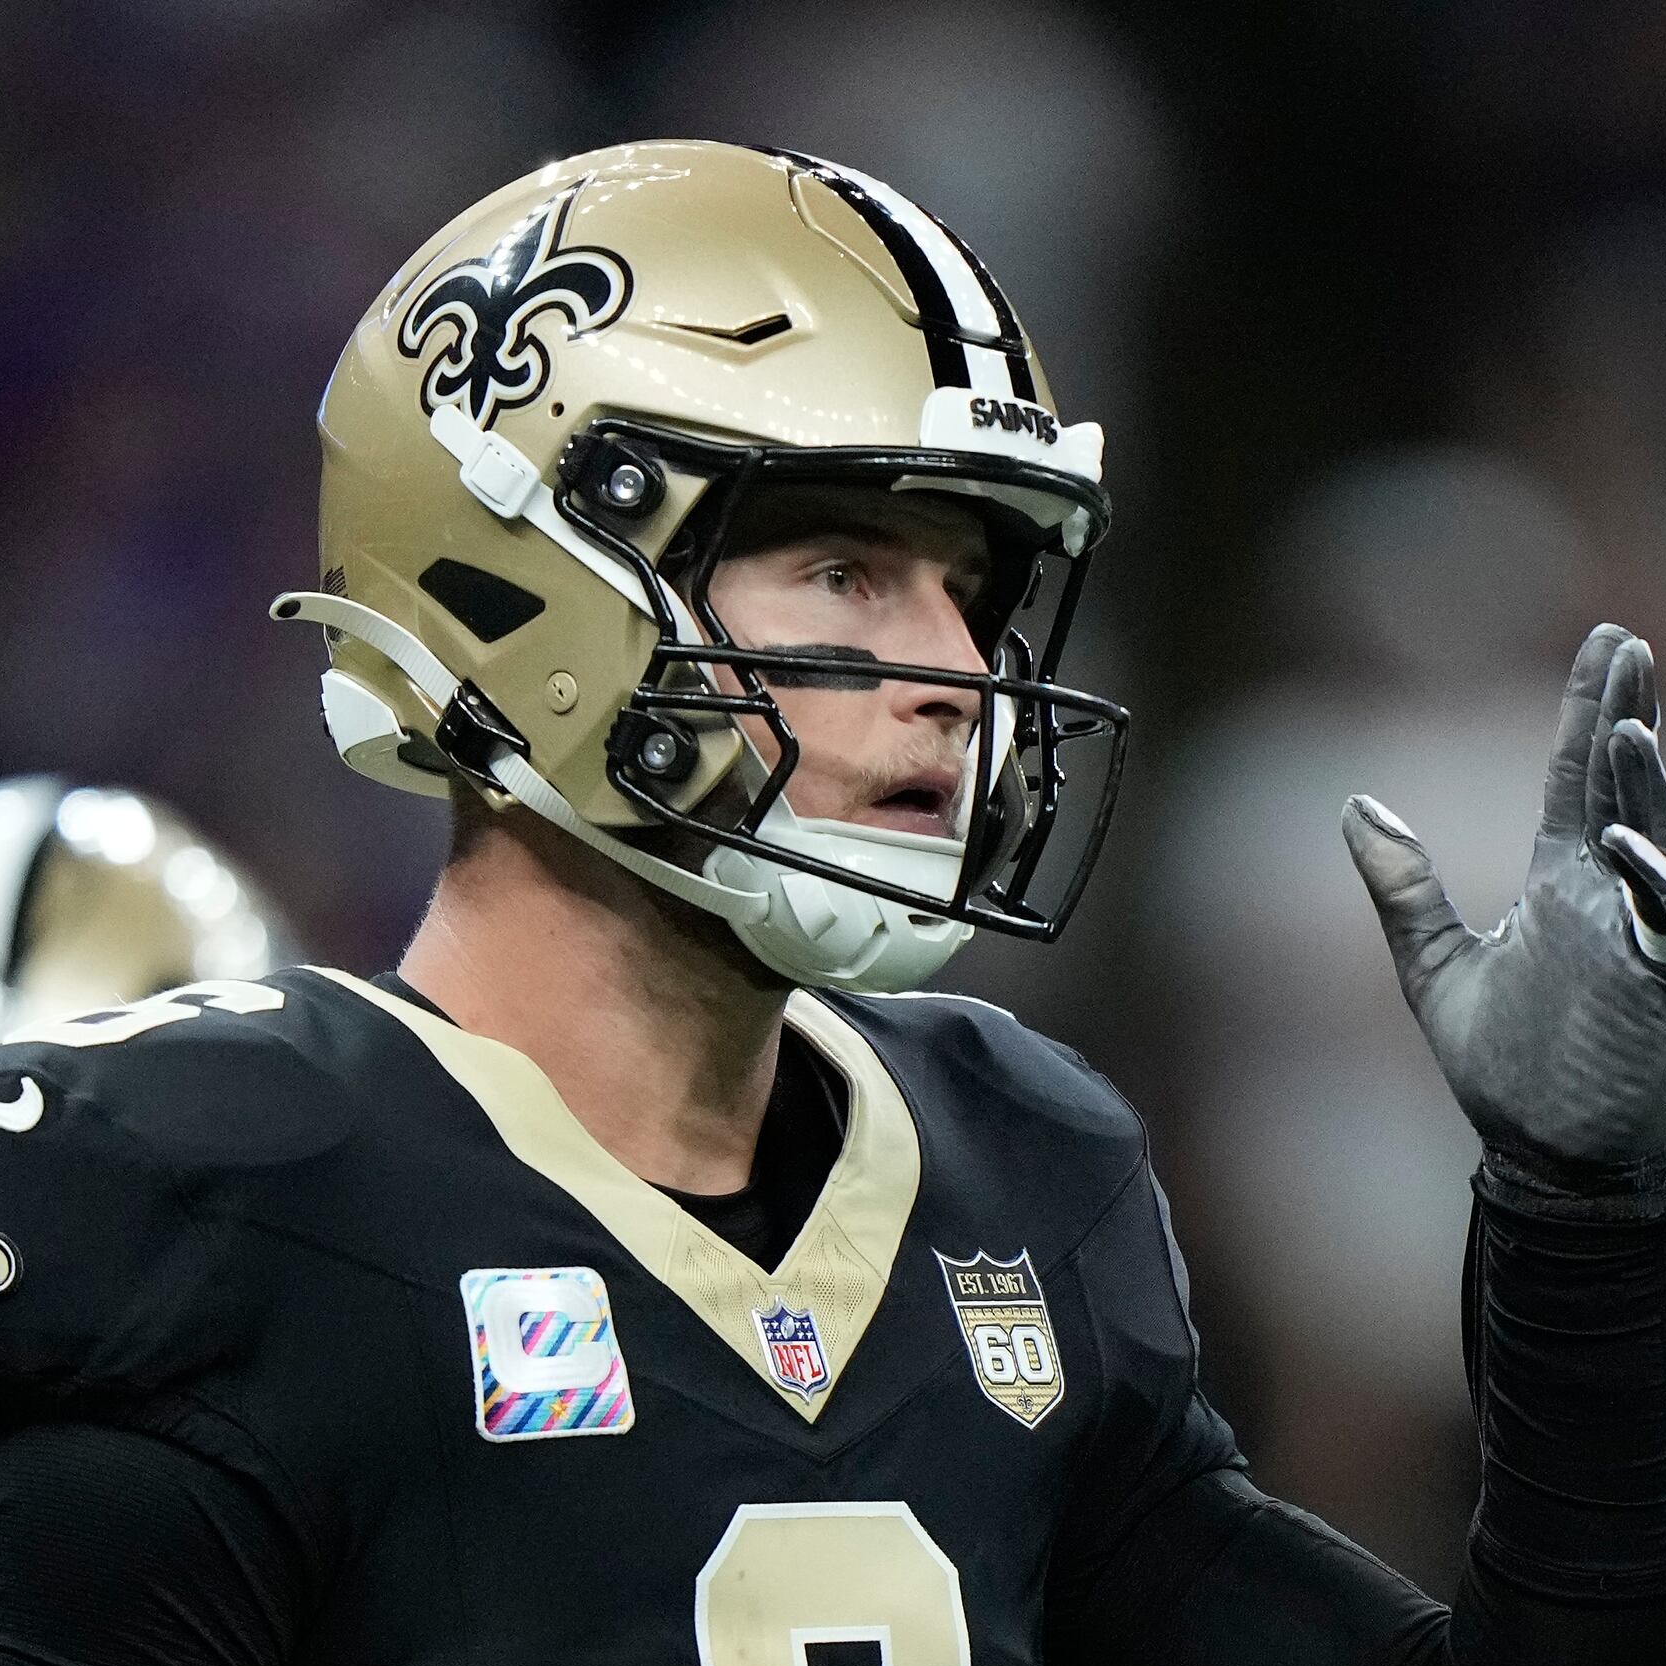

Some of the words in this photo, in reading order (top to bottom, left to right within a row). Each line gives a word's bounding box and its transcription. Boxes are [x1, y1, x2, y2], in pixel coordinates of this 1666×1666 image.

[970, 397, 1058, 445] SAINTS
[956, 1272, 990, 1295] EST.
[987, 1272, 1027, 1295] 1967
[484, 1279, 613, 1393] C
[973, 1325, 1055, 1385] 60
[774, 1344, 822, 1383] NFL
